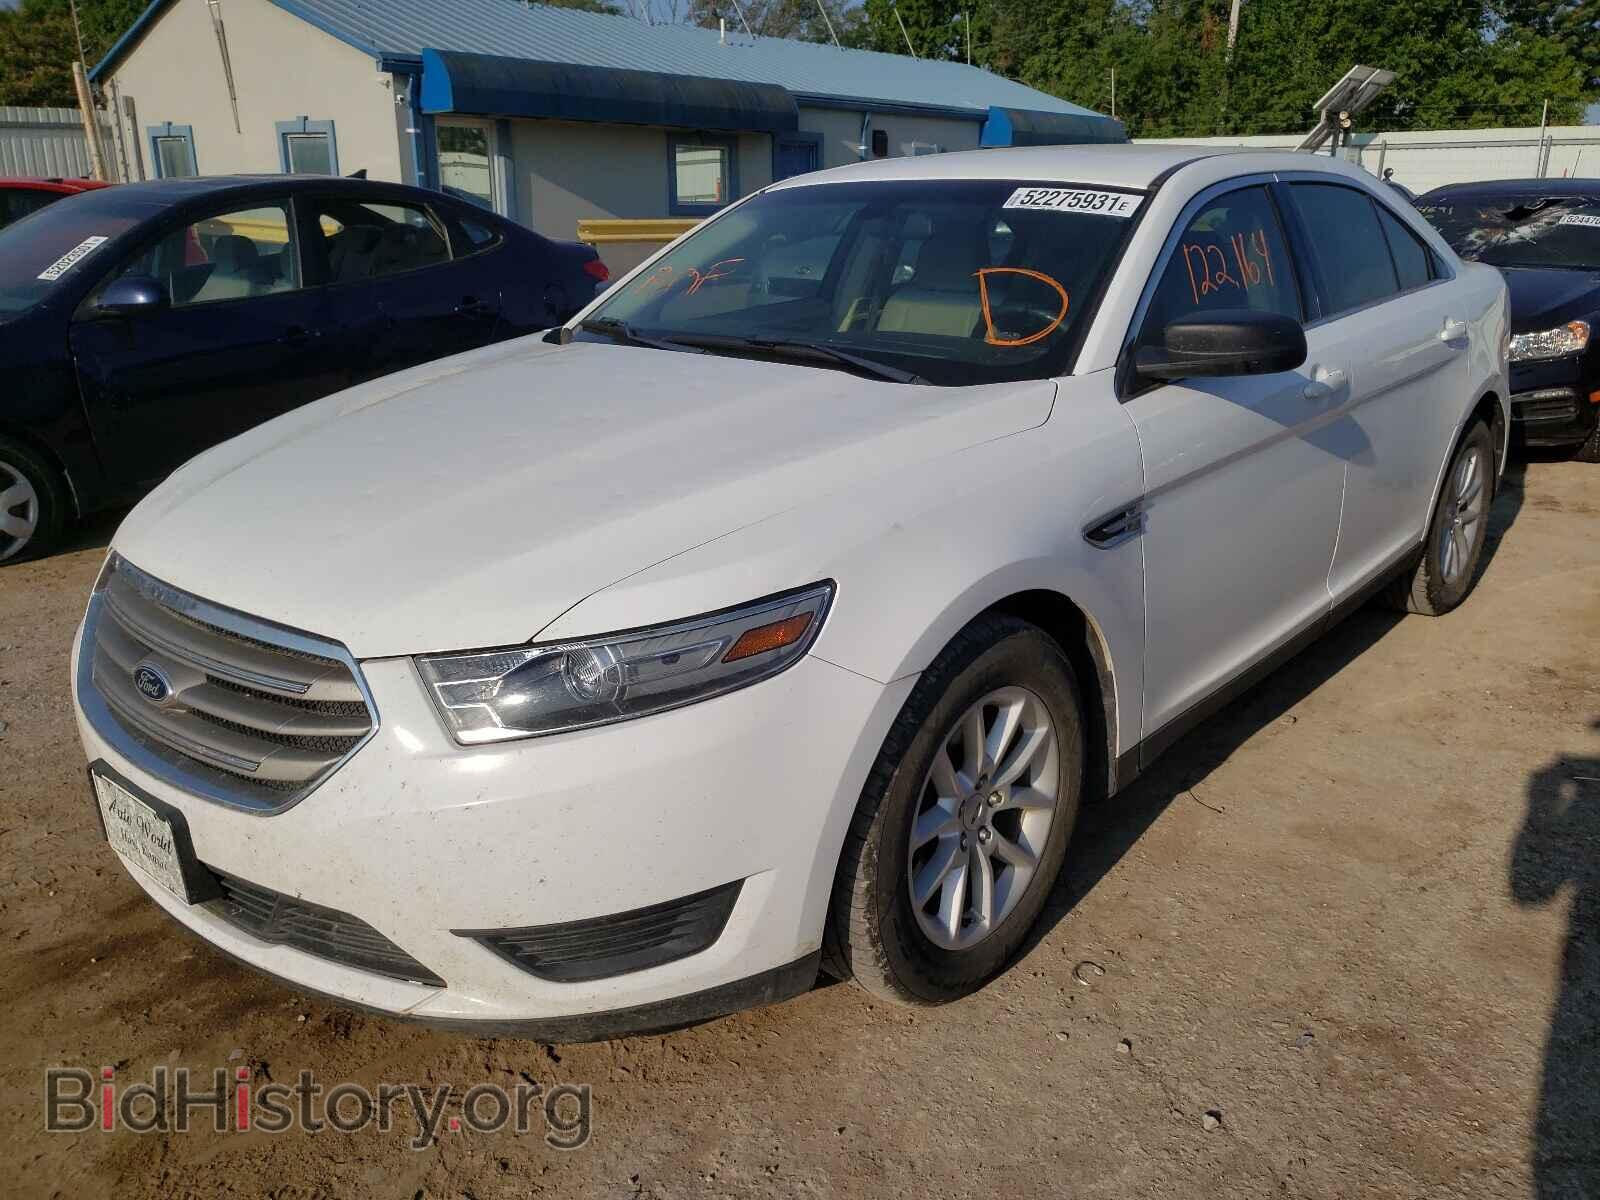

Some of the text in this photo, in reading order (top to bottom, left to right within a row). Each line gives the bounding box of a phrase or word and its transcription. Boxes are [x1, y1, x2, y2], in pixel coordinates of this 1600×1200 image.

[1020, 190, 1121, 212] 52275931
[1118, 201, 1129, 211] E
[969, 267, 1069, 346] D
[138, 670, 161, 696] Ford
[136, 815, 173, 855] World
